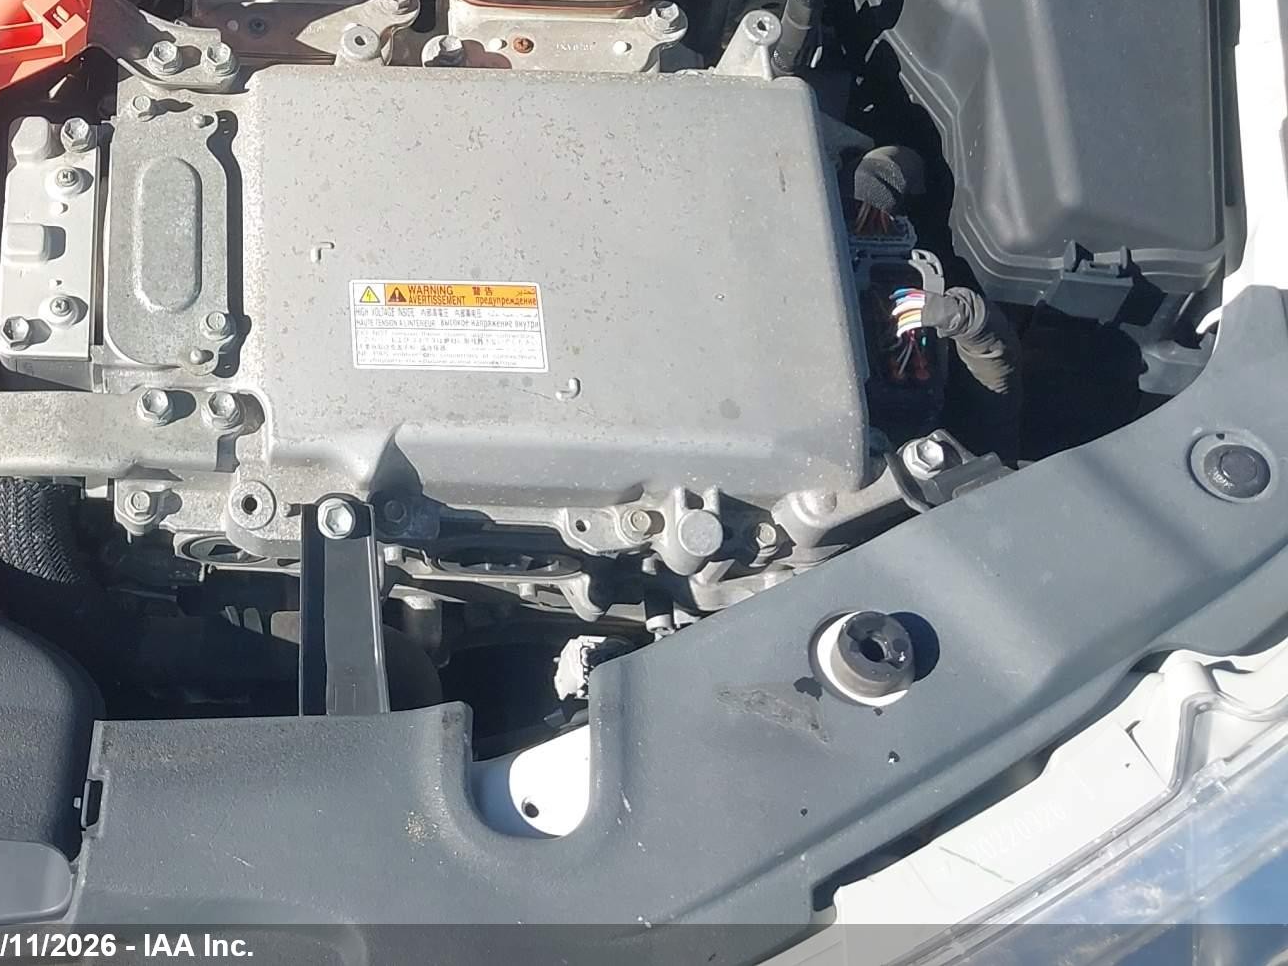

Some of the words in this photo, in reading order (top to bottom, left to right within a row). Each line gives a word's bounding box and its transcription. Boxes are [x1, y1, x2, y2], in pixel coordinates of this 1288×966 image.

[407, 285, 453, 296] WARNING
[408, 295, 466, 305] AVERTISSEMENT
[475, 296, 537, 307] предупреждение
